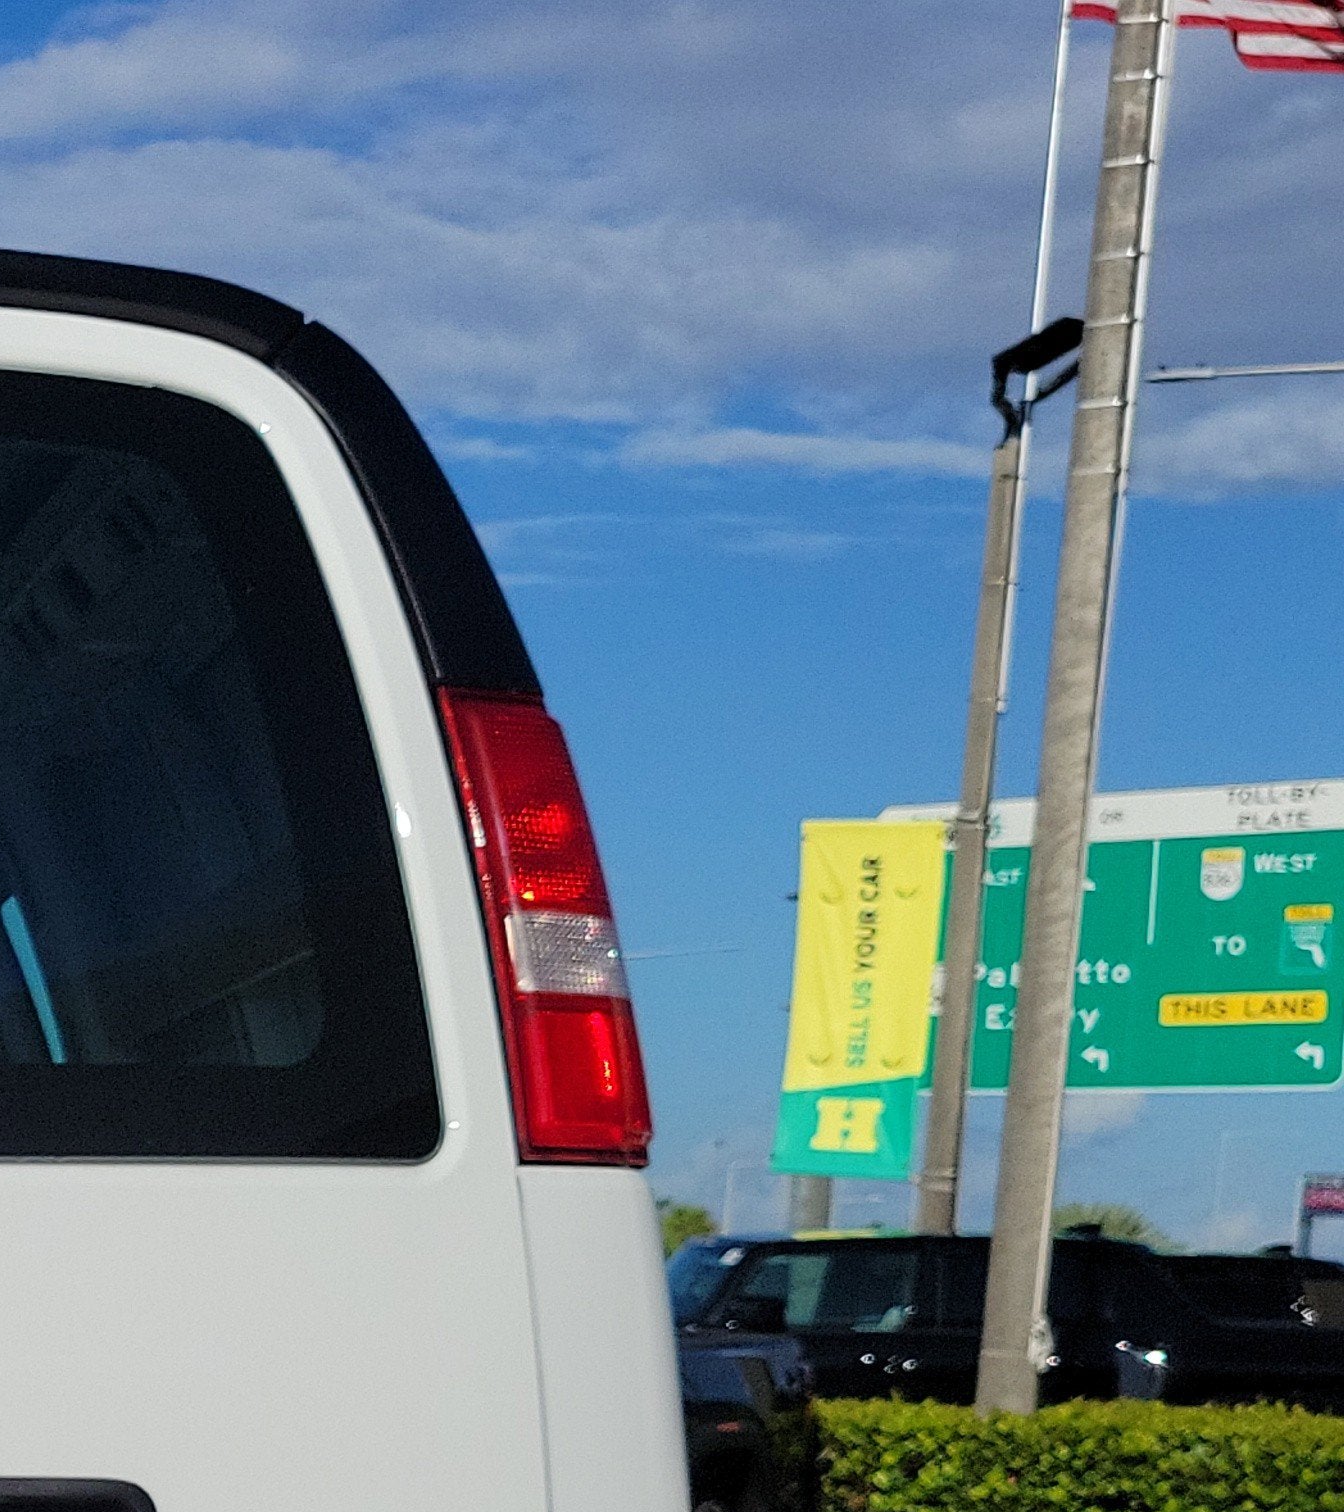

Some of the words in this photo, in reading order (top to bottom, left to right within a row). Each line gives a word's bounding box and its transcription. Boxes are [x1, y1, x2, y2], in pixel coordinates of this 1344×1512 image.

[1236, 808, 1311, 830] PLATE
[1254, 852, 1317, 873] WEST
[860, 856, 882, 902] CAR
[983, 868, 1023, 886] AST
[855, 910, 879, 973] YOUR
[1212, 934, 1247, 956] TO
[852, 979, 873, 1010] US
[1171, 1000, 1227, 1019] THIS
[1243, 998, 1316, 1018] LANE
[844, 1016, 871, 1069] SELL
